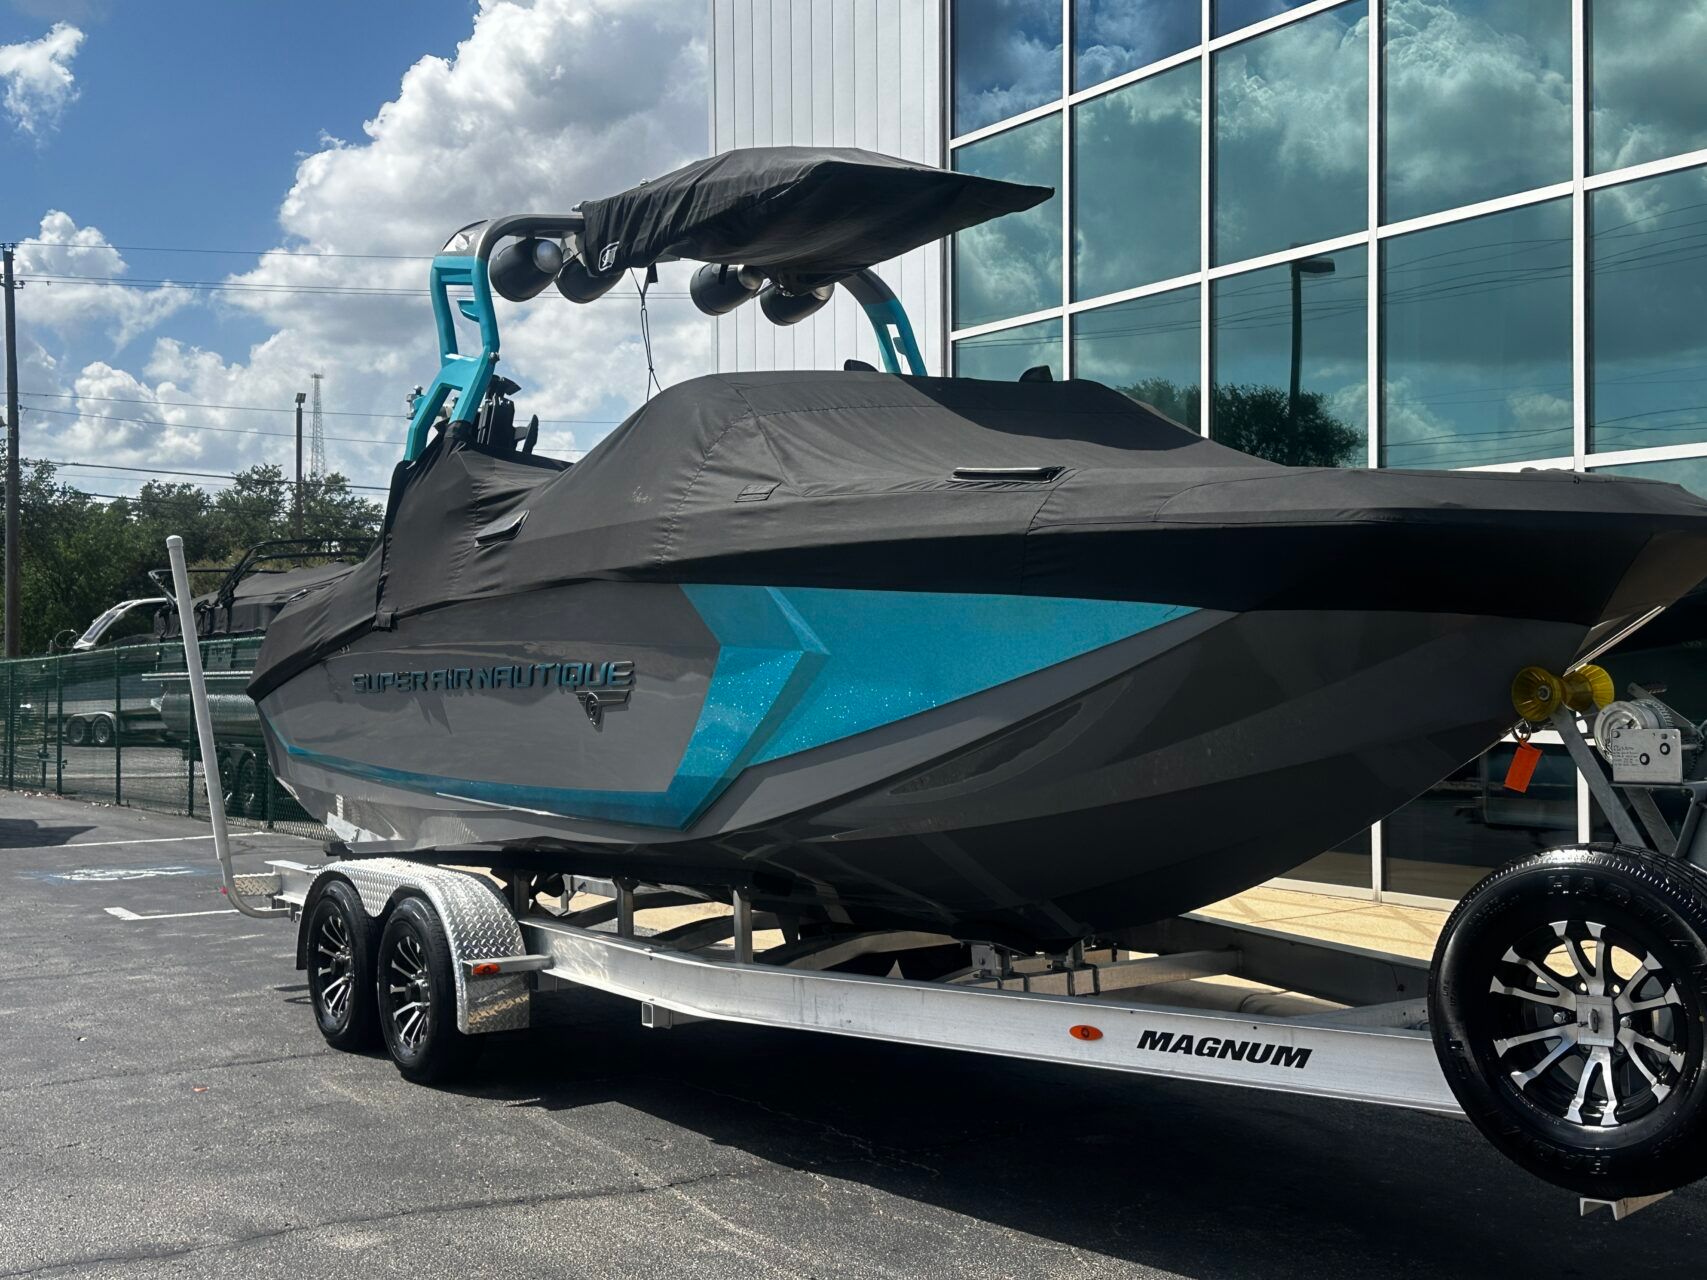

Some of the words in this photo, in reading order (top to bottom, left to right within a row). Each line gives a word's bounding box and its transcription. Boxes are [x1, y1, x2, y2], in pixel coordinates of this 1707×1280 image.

[352, 671, 428, 694] SUPER
[431, 667, 473, 690] AIR
[478, 660, 635, 689] NAUTIQUE
[1137, 1030, 1313, 1069] MAGNUM
